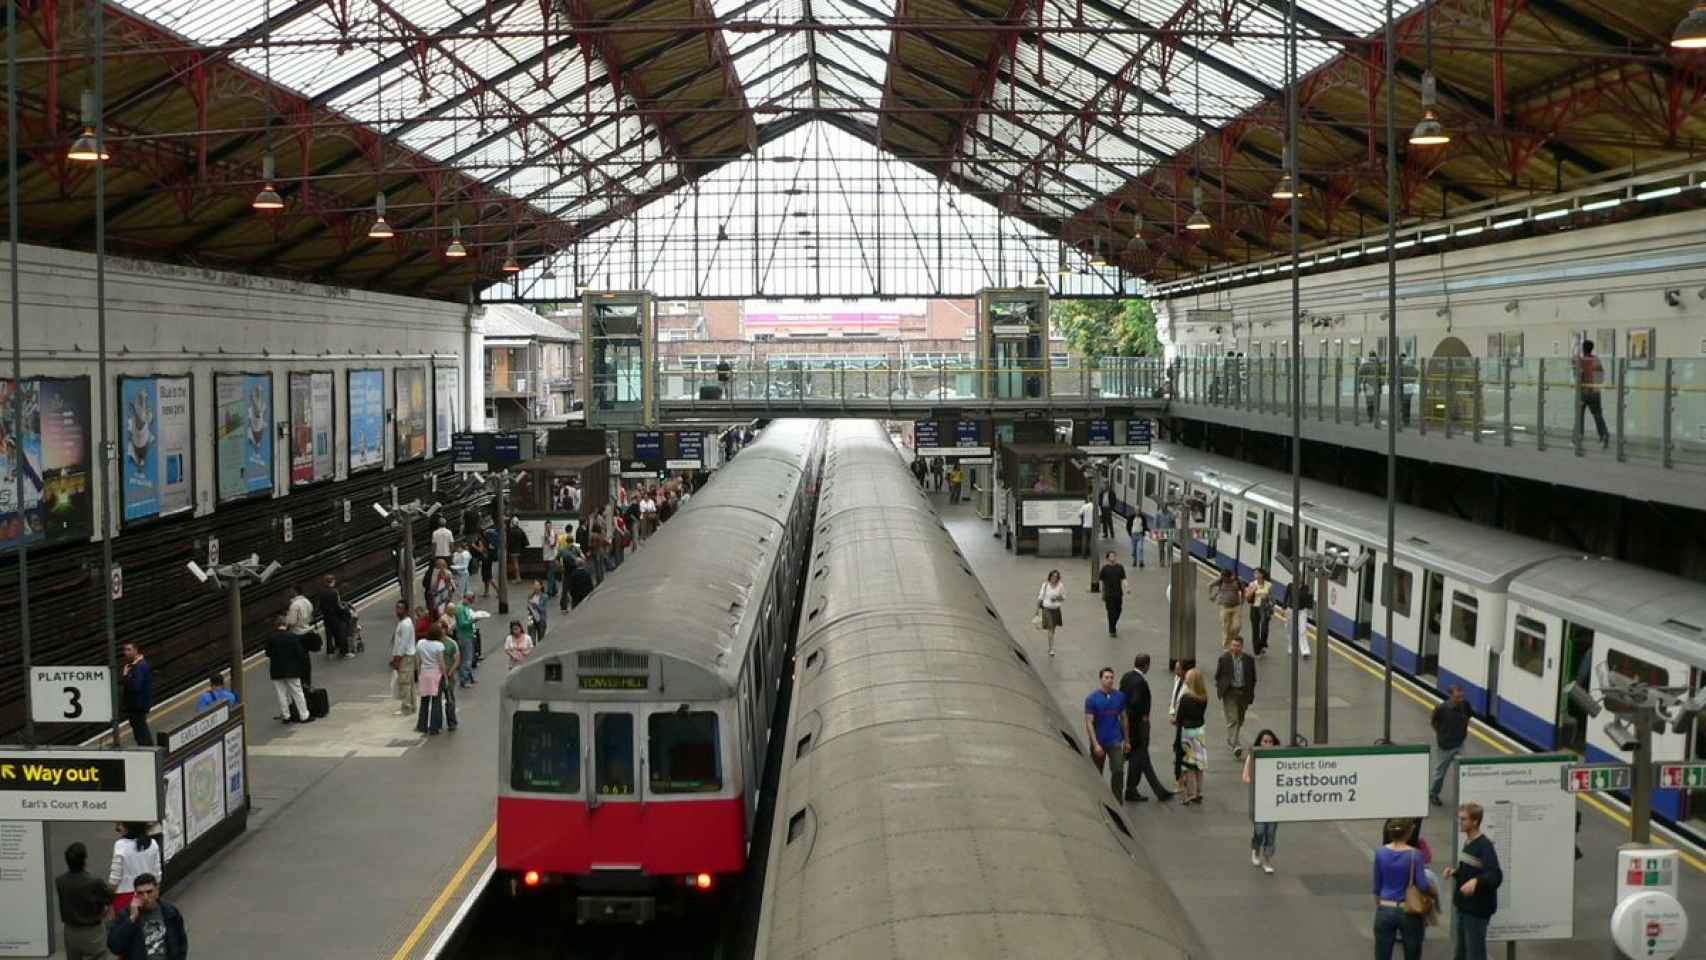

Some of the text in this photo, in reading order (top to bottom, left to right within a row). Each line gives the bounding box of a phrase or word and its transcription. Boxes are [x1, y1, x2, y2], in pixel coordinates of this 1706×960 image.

[38, 670, 104, 681] PLATFORM
[63, 686, 82, 719] 3
[1276, 759, 1337, 770] District line
[22, 764, 100, 785] Way out
[1276, 771, 1358, 787] Eastbound
[22, 799, 107, 809] Earl's Court Road
[1276, 788, 1357, 807] platform 2
